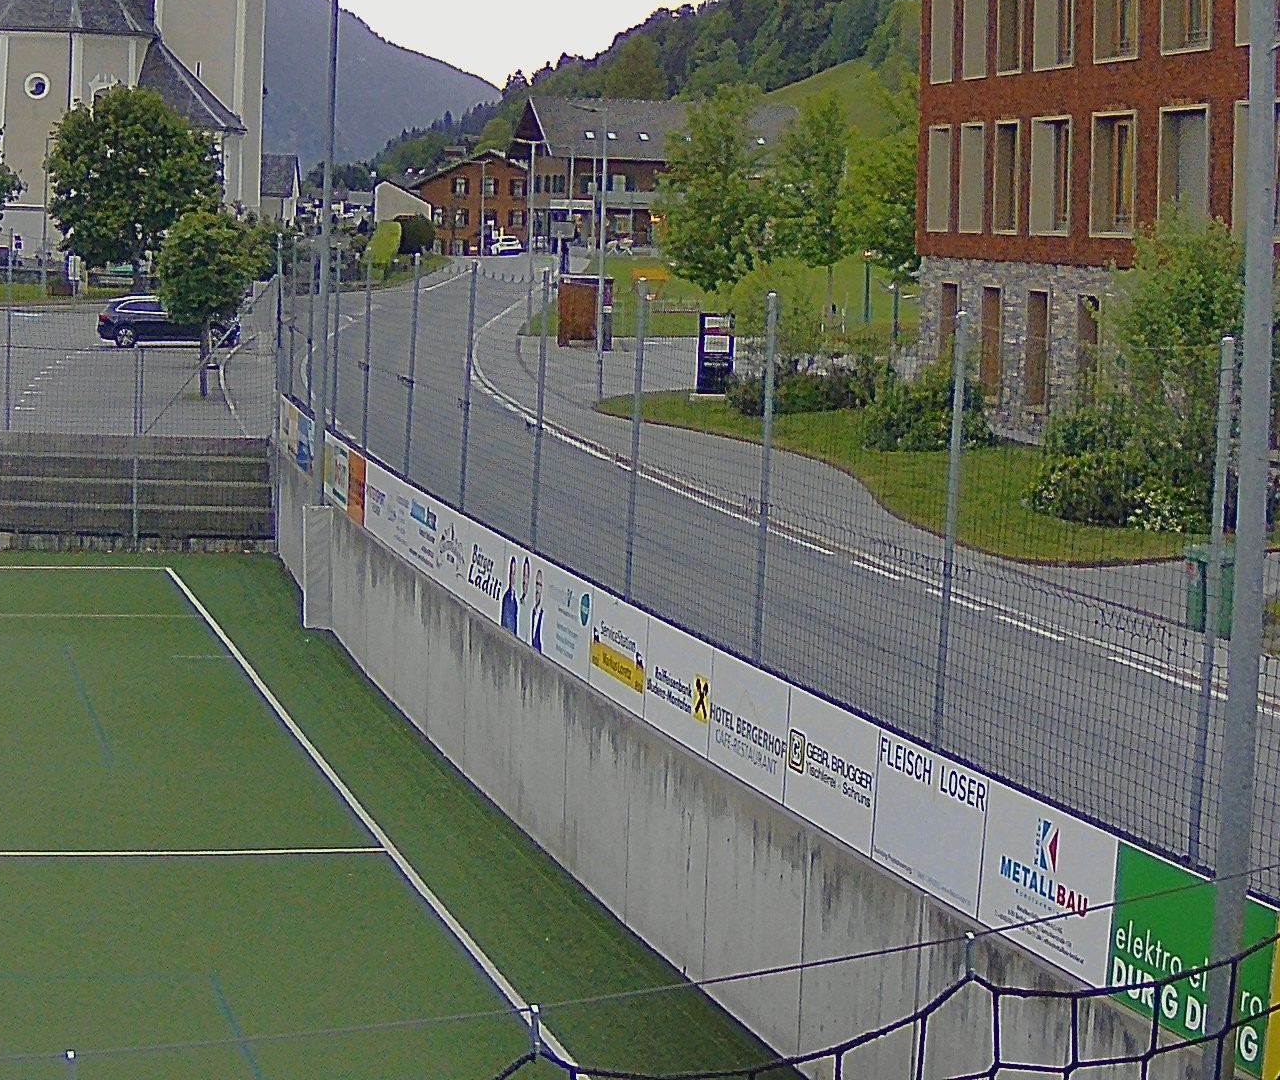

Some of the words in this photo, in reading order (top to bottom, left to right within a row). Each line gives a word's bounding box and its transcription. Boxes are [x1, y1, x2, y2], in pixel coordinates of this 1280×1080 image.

[710, 702, 734, 732] HOTEL
[736, 717, 788, 758] BERGERHOF
[831, 755, 873, 791] BRUGGER
[842, 781, 871, 808] Schruns
[880, 736, 933, 786] FLEISCH
[939, 765, 986, 812] LOSER
[1000, 855, 1089, 918] METALLBAU
[1115, 920, 1182, 976] elektro
[1112, 957, 1179, 1019] DURG
